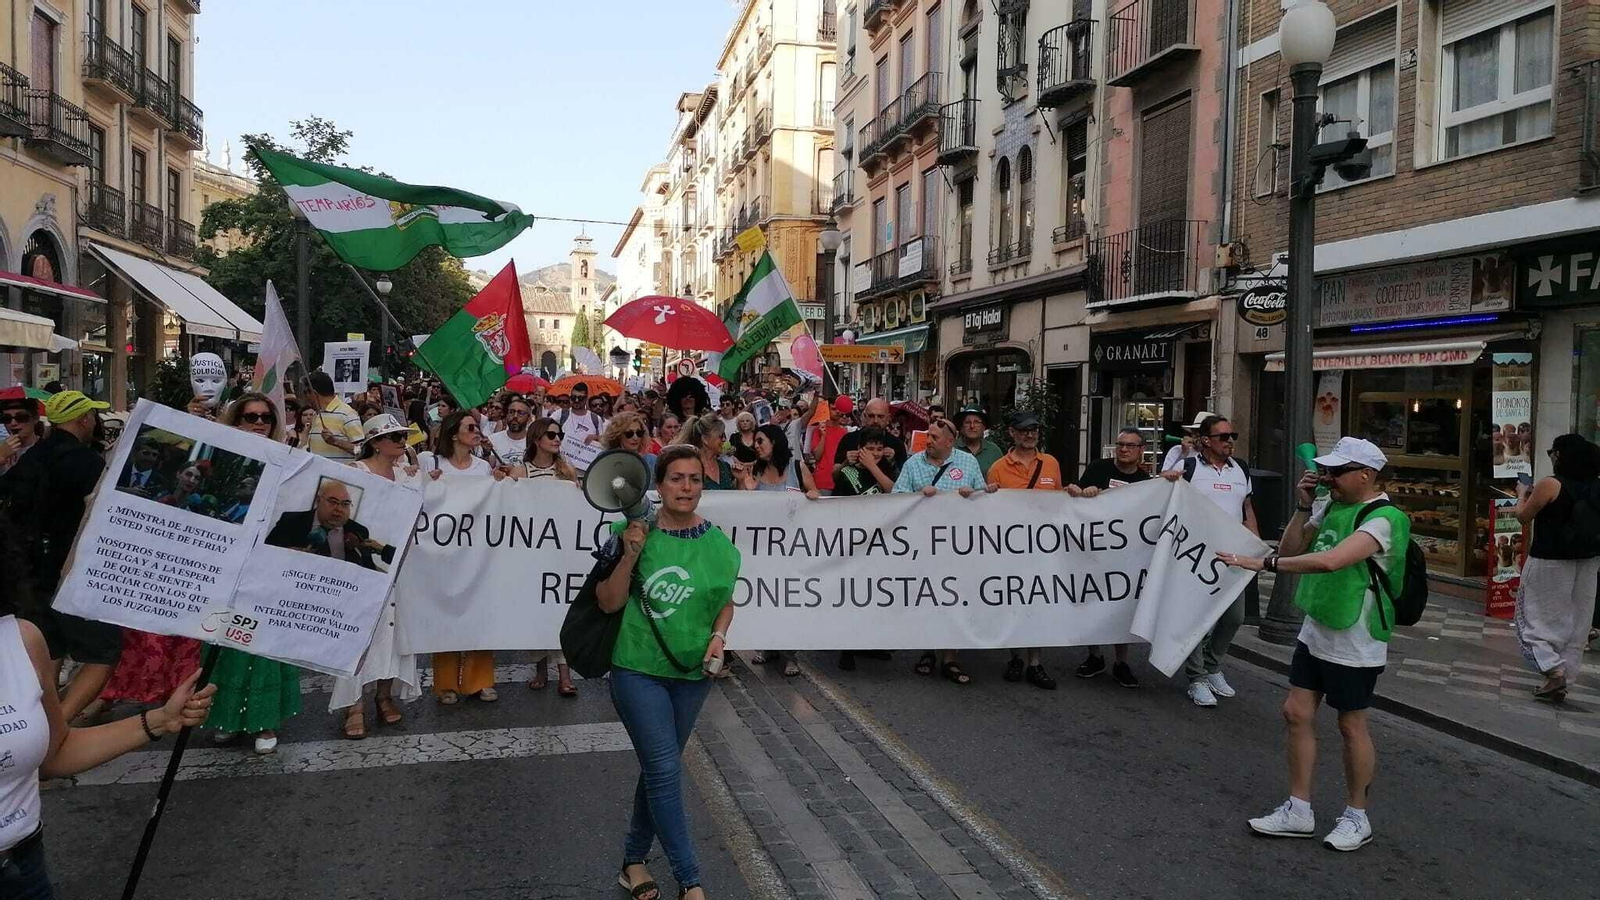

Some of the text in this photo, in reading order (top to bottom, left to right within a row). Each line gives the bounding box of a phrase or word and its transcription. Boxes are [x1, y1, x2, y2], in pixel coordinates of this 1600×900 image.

[1322, 280, 1346, 306] PAN
[965, 313, 972, 328] El
[972, 311, 982, 330] Taj
[1256, 327, 1268, 338] 48
[1106, 342, 1167, 361] GRANART
[1353, 356, 1367, 367] LA
[1370, 354, 1415, 366] BLANCA
[1418, 350, 1469, 363] PALOMA
[109, 516, 228, 554] USTED SIGUE DE FERIA?
[115, 506, 166, 526] MINISTRA
[168, 520, 181, 530] DE
[183, 525, 228, 543] JUSTICIA
[229, 537, 237, 545] Y
[413, 510, 474, 547] POR
[485, 514, 563, 550] UNA
[96, 547, 216, 584] HUELGA Y A LA ESPERA
[97, 536, 222, 575] NOSOTROS SEGUIMOS DE
[746, 526, 920, 561] TRAMPAS,
[931, 518, 1128, 556] FUNCIONES
[1139, 514, 1229, 596] CARAS,
[86, 568, 210, 605] NEGOCIAR CON LOS QUE
[103, 560, 202, 591] DE QUE SE SIENTE A
[319, 575, 359, 592] PERDIDO
[86, 580, 202, 613] SACAN EL TRABAJO EN
[294, 581, 342, 597] TONTXU!!!
[650, 580, 695, 605] CSIF
[832, 576, 968, 608] JUSTAS.
[102, 595, 179, 619] LOS JUZGADOS
[254, 605, 327, 625] INTERLOCUTOR
[278, 599, 345, 619] QUEREMOS UN
[231, 614, 259, 631] SPJ
[268, 618, 340, 640] PARA NEGOCIAR
[225, 627, 253, 643] USO
